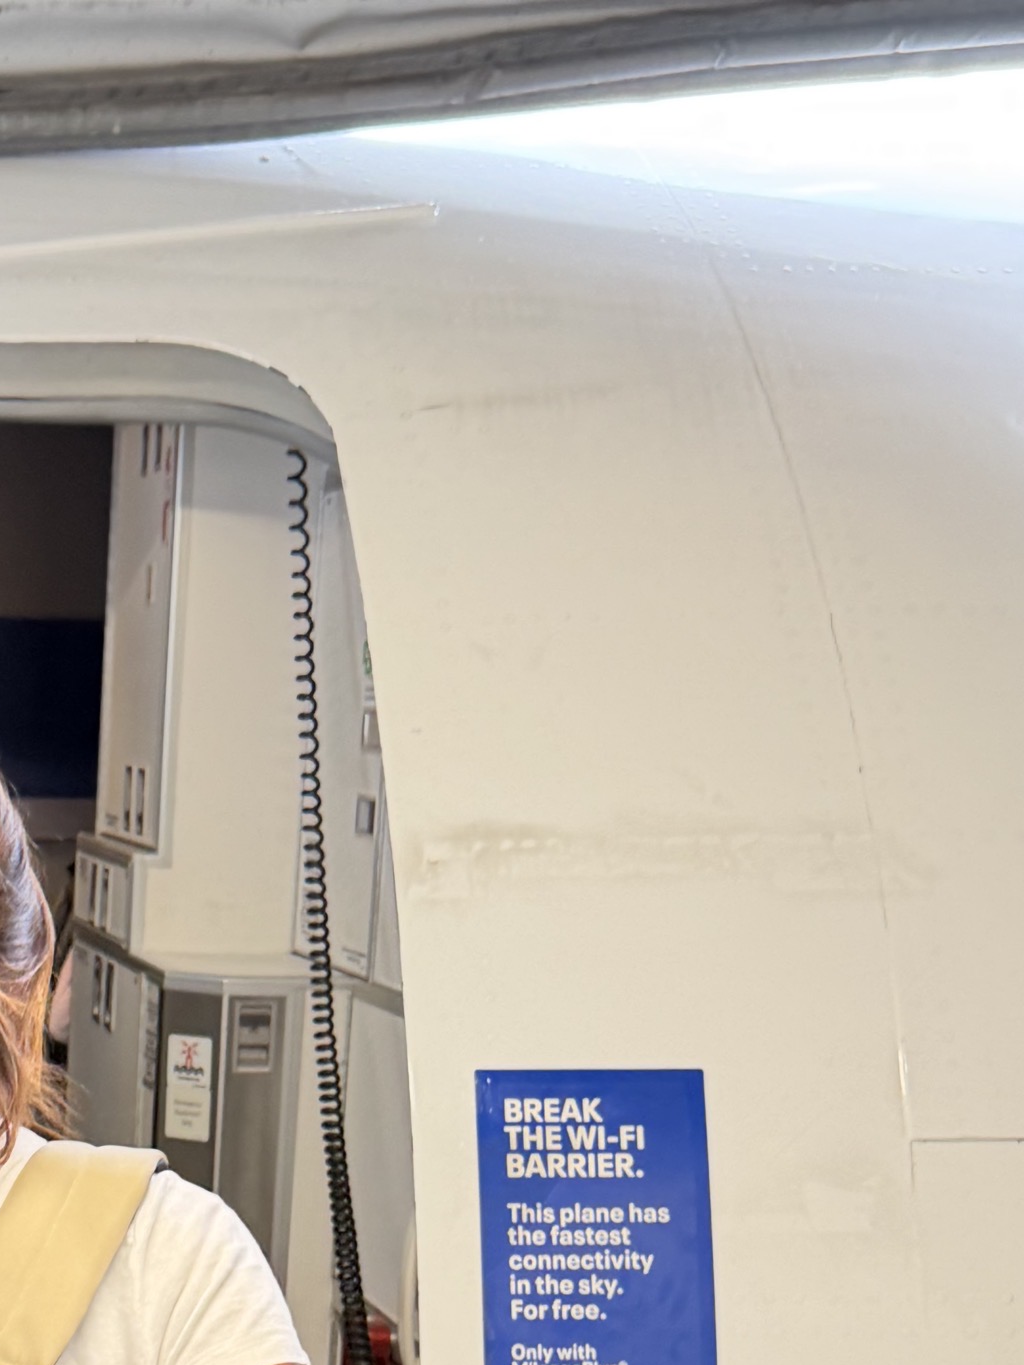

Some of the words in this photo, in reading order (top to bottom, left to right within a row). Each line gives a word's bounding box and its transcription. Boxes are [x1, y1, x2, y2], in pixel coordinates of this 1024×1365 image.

[503, 1097, 604, 1124] BREAK
[503, 1125, 563, 1151] THE
[566, 1124, 645, 1151] WI-FI
[506, 1152, 645, 1179] BARRIER.
[506, 1202, 556, 1224] This
[557, 1202, 627, 1230] plane
[628, 1202, 671, 1224] has
[507, 1224, 547, 1247] the
[549, 1224, 632, 1247] fastest
[508, 1248, 655, 1277] connectivity
[509, 1273, 532, 1296] in
[534, 1273, 575, 1296] the
[578, 1273, 624, 1300] sky.
[510, 1298, 549, 1321] For
[551, 1298, 607, 1321] free.
[510, 1342, 554, 1365] Only
[556, 1342, 597, 1362] with
